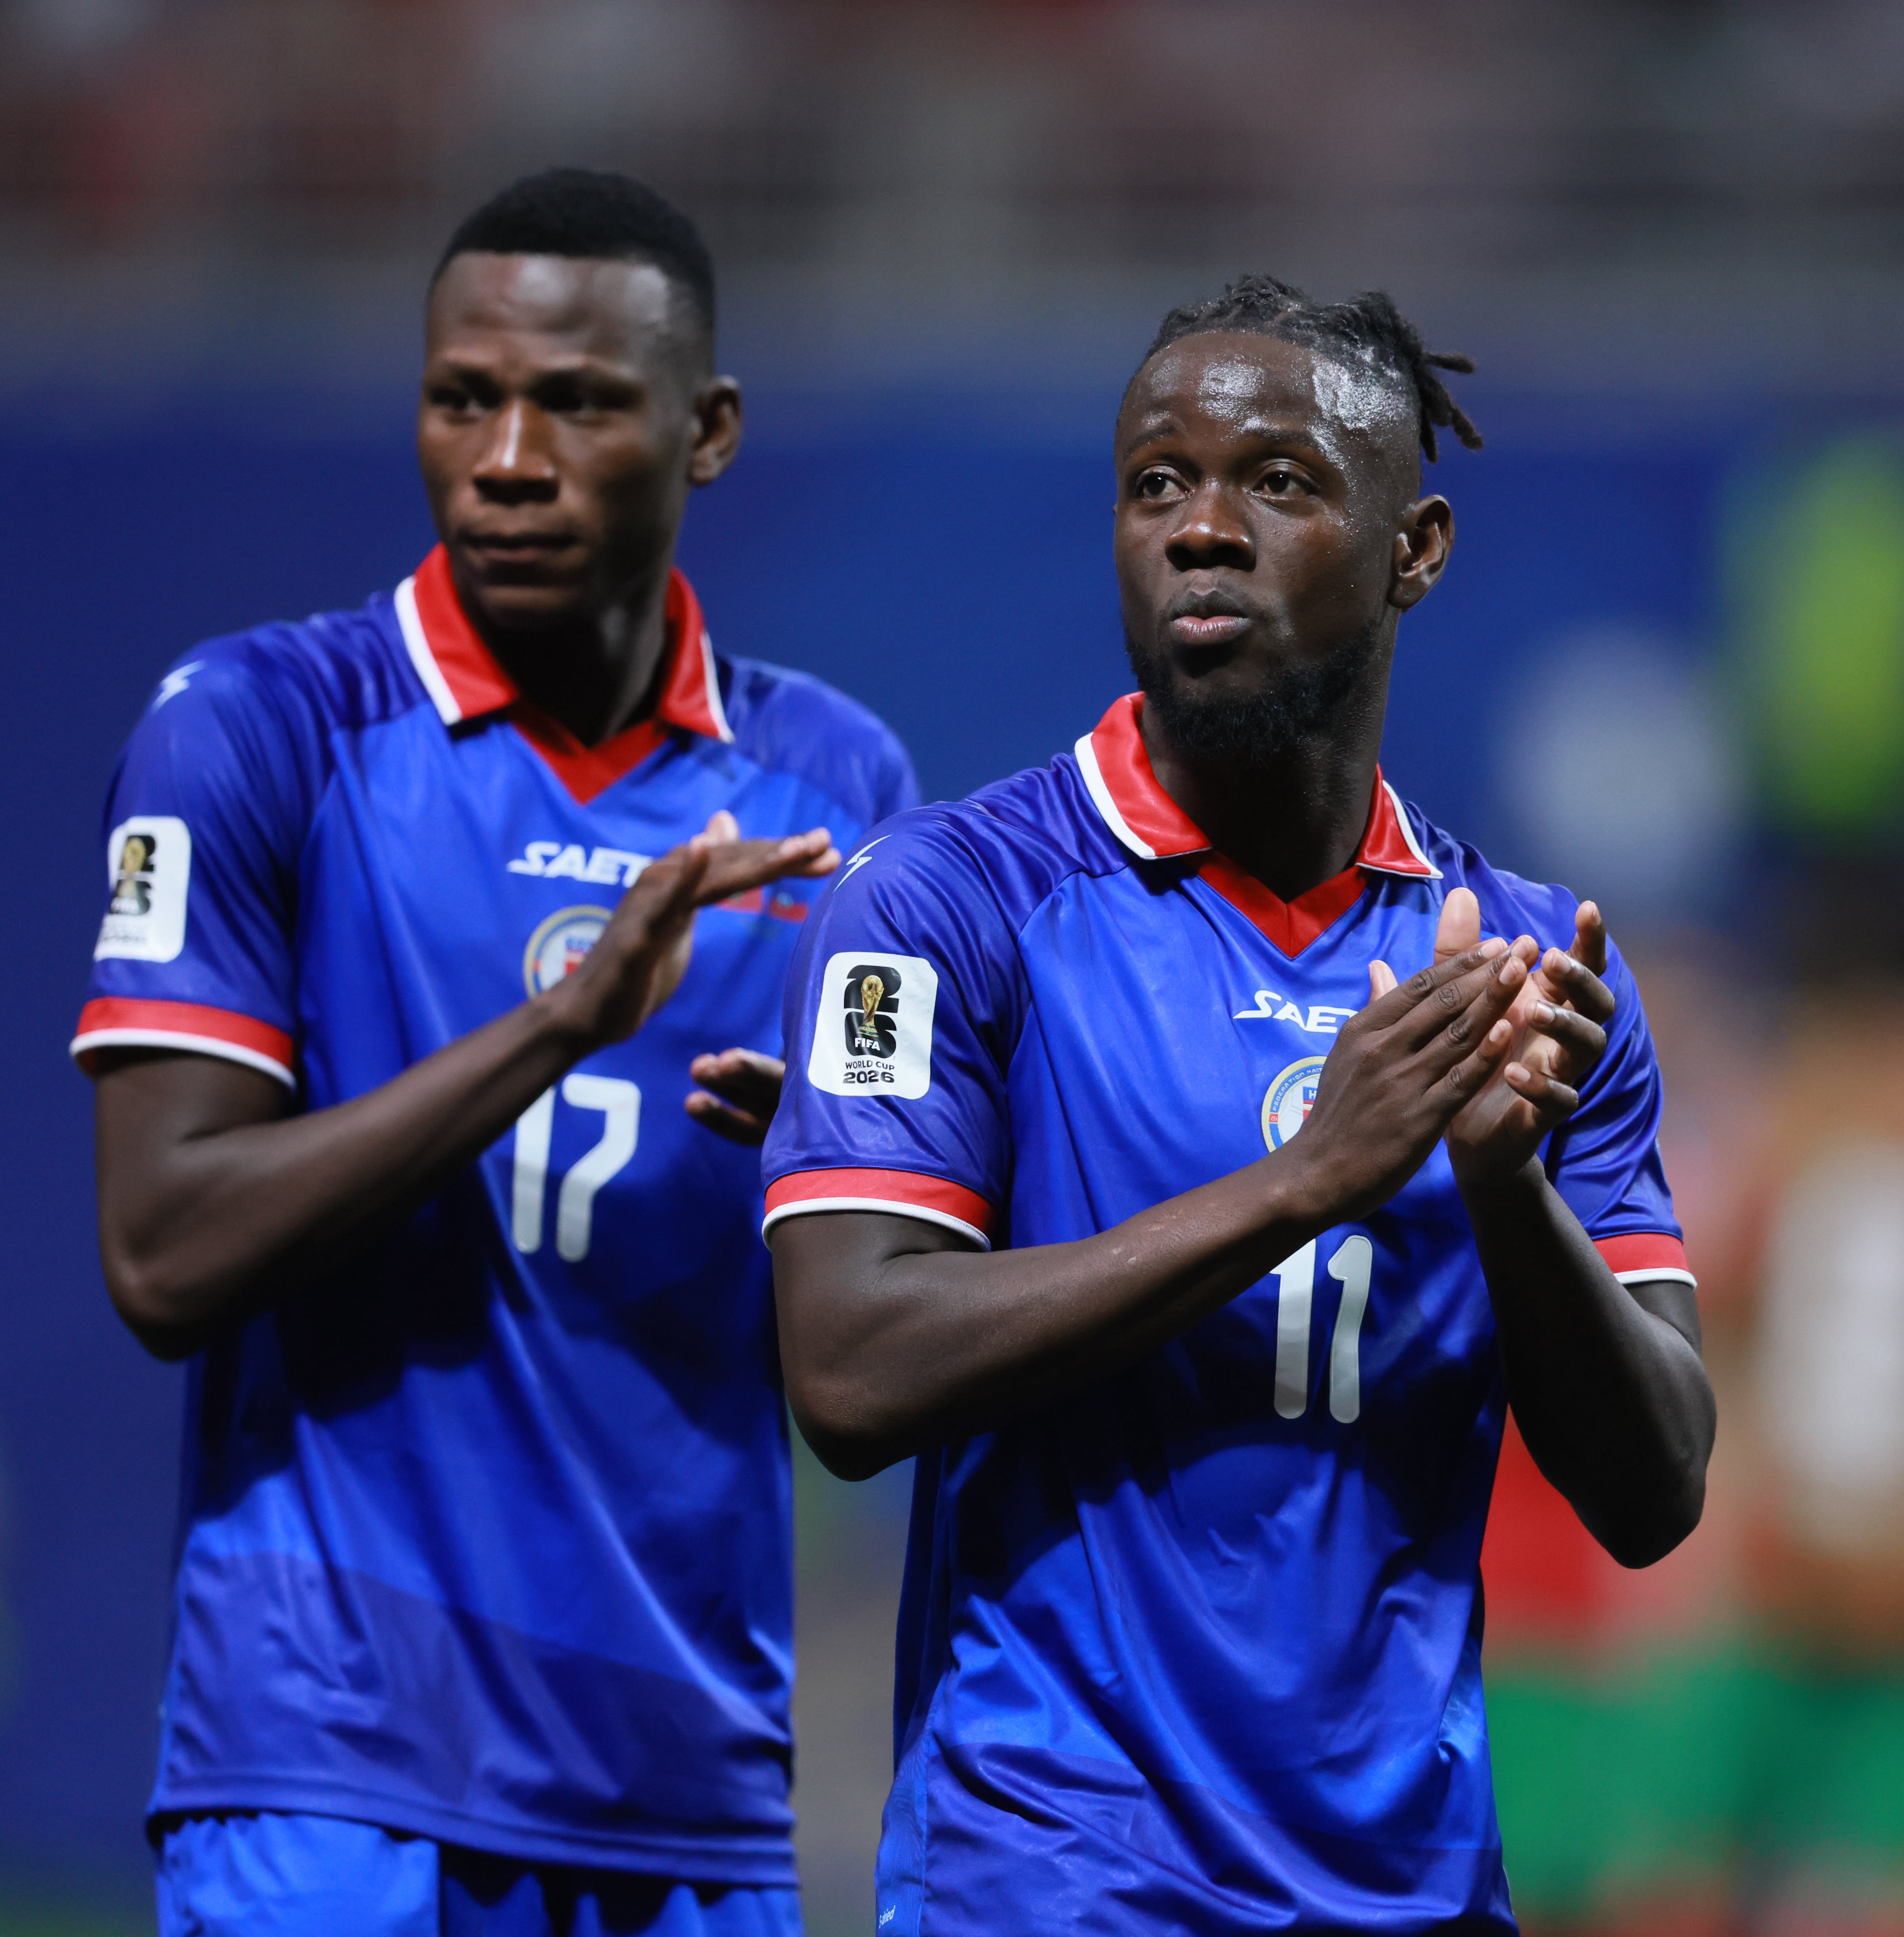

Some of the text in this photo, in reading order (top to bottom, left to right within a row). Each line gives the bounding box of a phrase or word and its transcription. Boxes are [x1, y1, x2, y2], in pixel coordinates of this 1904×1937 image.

[854, 1037, 881, 1051] FIFA
[845, 1060, 894, 1070] WORLD CUP
[842, 1070, 894, 1084] 2026
[513, 1073, 642, 1263] 17
[1269, 1235, 1372, 1424] 11
